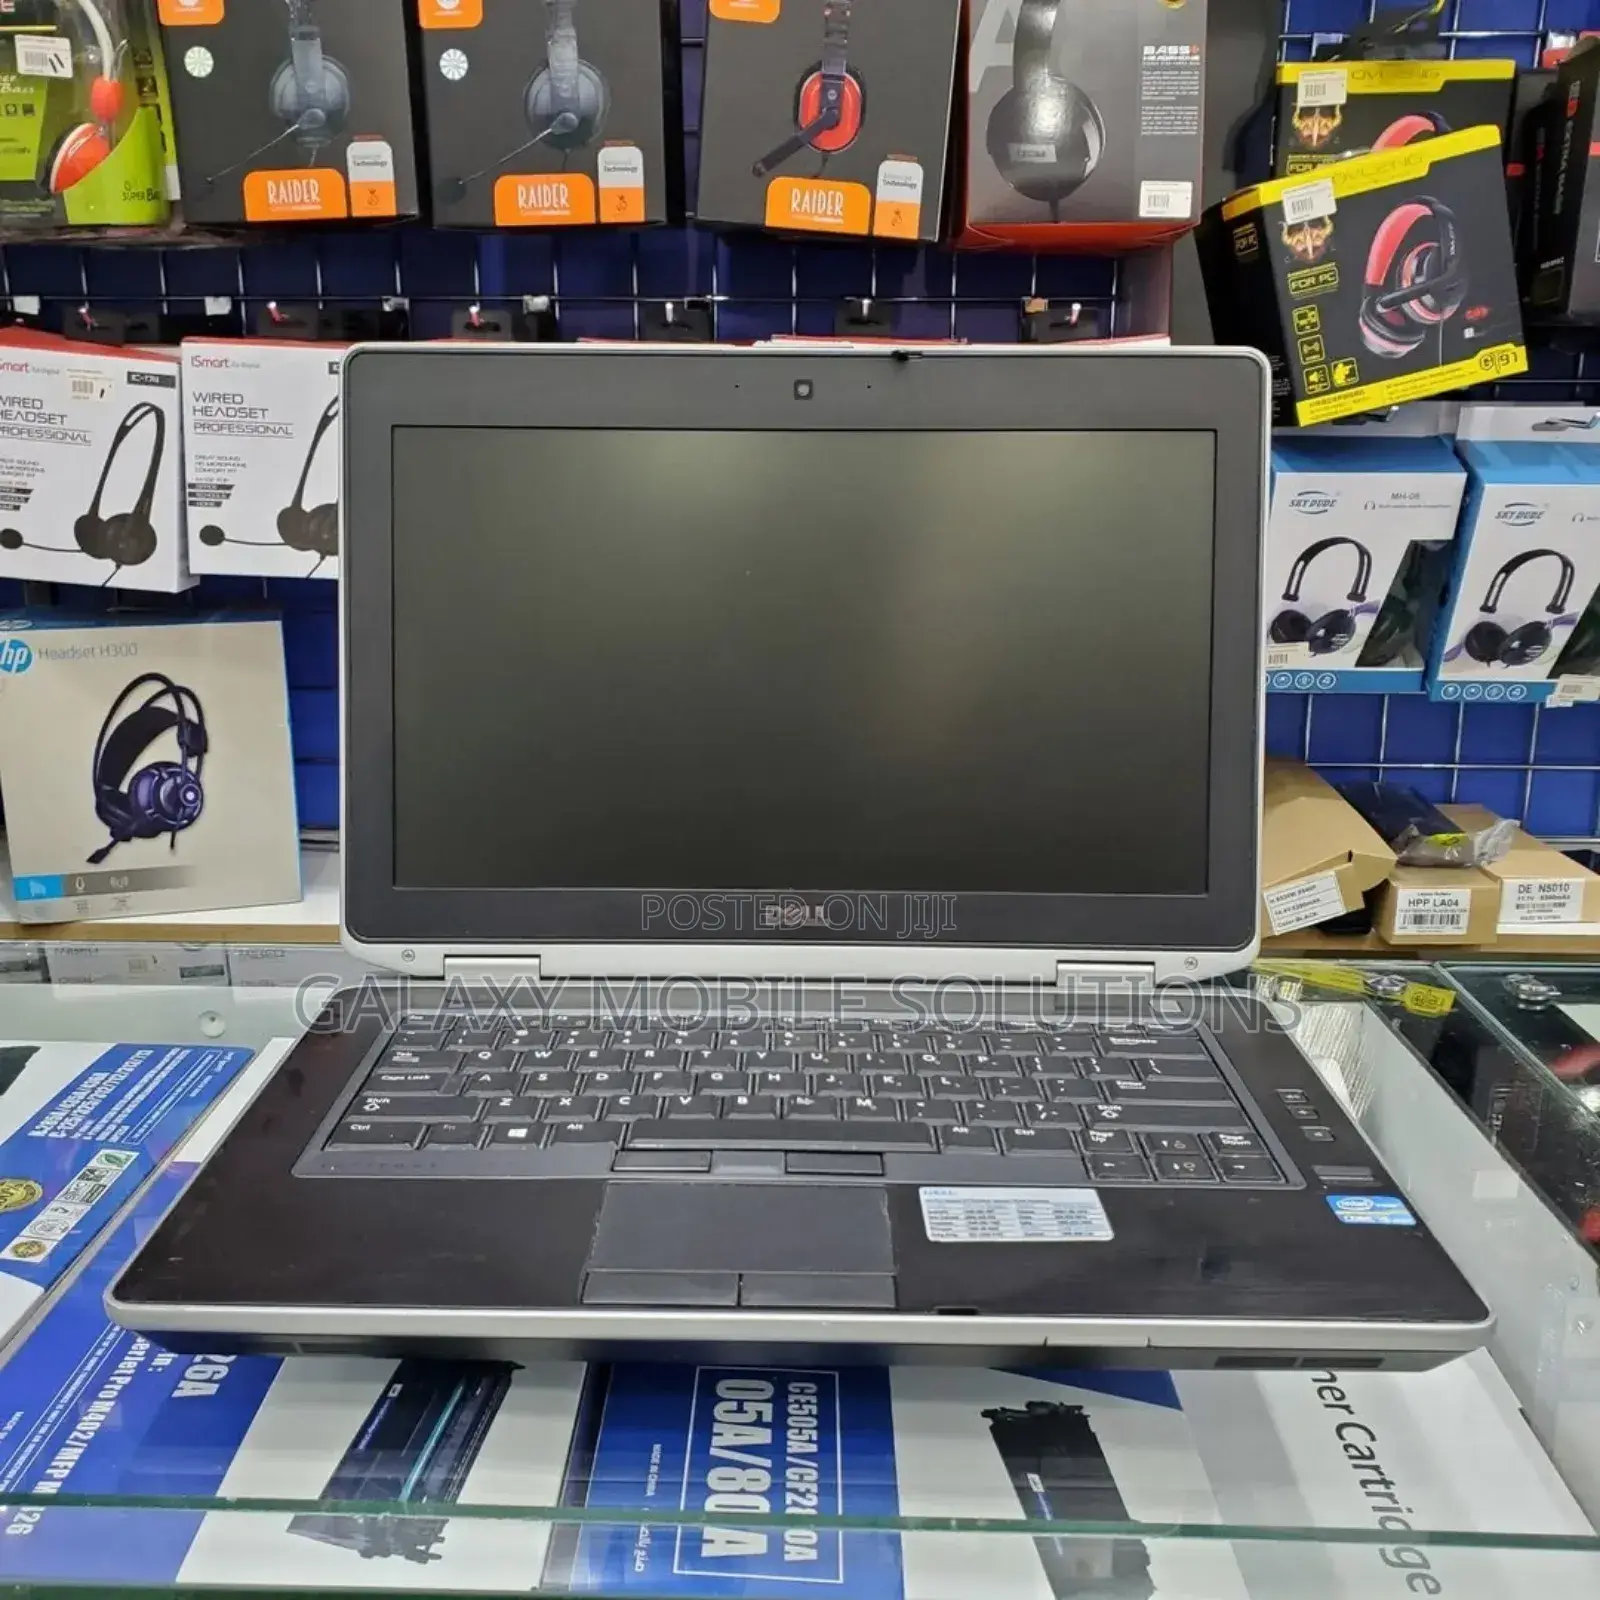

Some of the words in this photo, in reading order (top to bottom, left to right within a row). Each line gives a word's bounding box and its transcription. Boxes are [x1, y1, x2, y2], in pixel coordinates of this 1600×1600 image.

[267, 179, 320, 205] RAIDER
[517, 184, 570, 209] RAIDER
[791, 188, 844, 216] RAIDER
[1291, 276, 1316, 290] FOR
[1318, 272, 1336, 282] PC
[193, 391, 244, 405] WIRED
[192, 406, 269, 419] HEADSET
[194, 422, 293, 435] PROFESSIONAL
[39, 644, 95, 660] Headset
[100, 642, 138, 657] H300
[0, 639, 28, 674] hp
[1518, 884, 1533, 894] DE
[1538, 883, 1570, 893] N5010
[1408, 898, 1430, 908] HPP
[1433, 898, 1459, 908] LA04
[645, 1050, 655, 1058] R
[757, 1051, 767, 1059] Y
[537, 1073, 548, 1081] S
[710, 1073, 723, 1081] G
[768, 1073, 780, 1081] H
[883, 1075, 895, 1083] K
[941, 1077, 951, 1085] L
[500, 1097, 513, 1106] Z
[559, 1097, 572, 1106] X
[619, 1096, 631, 1105] C
[679, 1096, 692, 1105] V
[737, 1096, 748, 1105] B
[856, 1098, 872, 1107] M
[566, 1123, 584, 1131] Alt
[1015, 1128, 1036, 1136] Ctrl
[98, 1375, 132, 1399] Pro
[701, 1378, 774, 1558] 05A/80A
